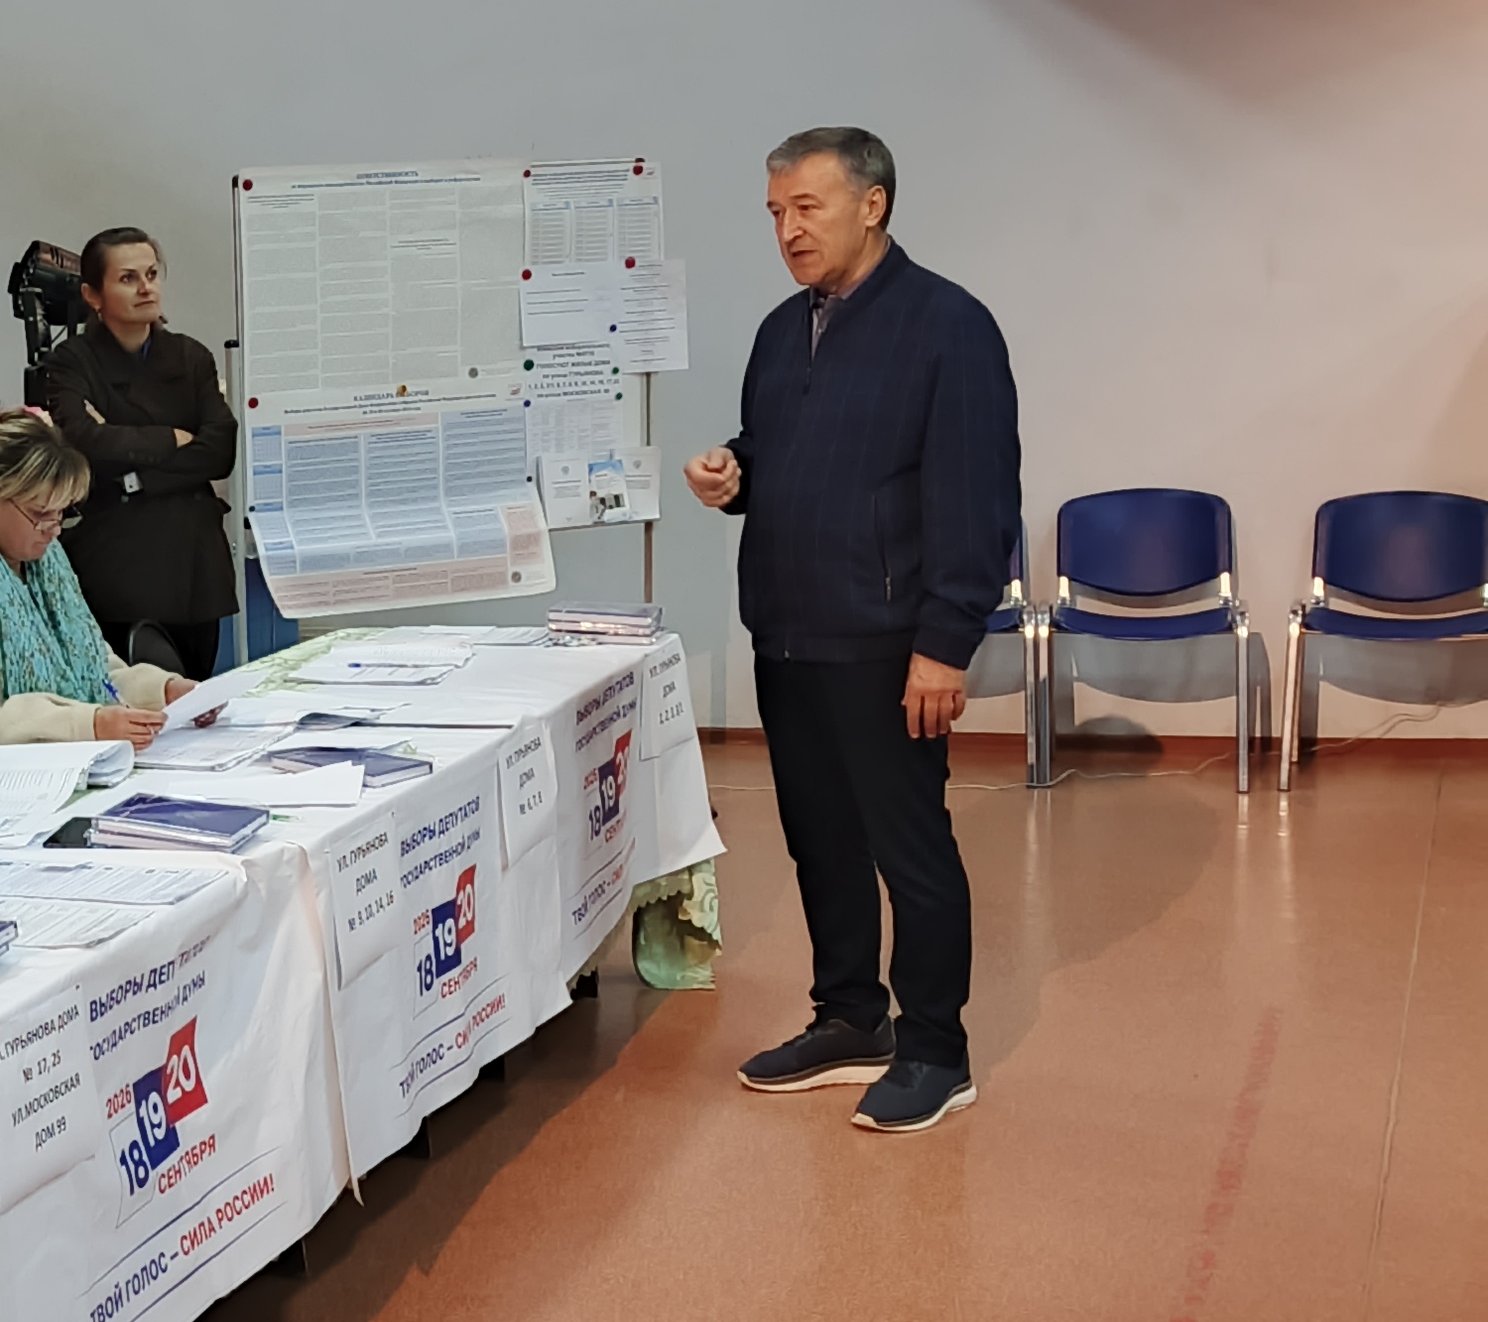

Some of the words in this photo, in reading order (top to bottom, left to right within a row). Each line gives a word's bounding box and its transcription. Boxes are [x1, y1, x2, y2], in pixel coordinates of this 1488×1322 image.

[602, 776, 616, 811] 19
[400, 821, 436, 857] ВЫБОРЫ
[438, 795, 480, 837] ДЕПУТАТОВ
[589, 805, 601, 840] 18
[356, 868, 378, 896] ДОМА
[458, 883, 473, 929] 20
[435, 918, 457, 961] 19
[89, 973, 144, 1022] ВЫБОРЫ
[417, 953, 434, 996] 18
[5, 1019, 56, 1057] ГУРЬЯНОВА
[57, 1004, 80, 1034] ДОМА
[90, 986, 180, 1060] ОСУДАРСТВЕННОЙ
[181, 970, 206, 1006] ДУМЫ
[166, 1044, 197, 1104] 20
[106, 1084, 132, 1119] 2026
[139, 1091, 167, 1148] 19
[35, 1125, 56, 1152] ДОМ
[57, 1115, 67, 1135] 99
[119, 1140, 150, 1196] 18
[158, 1134, 216, 1194] СЕНТЯБРЯ
[125, 1251, 169, 1302] ГОЛОС
[180, 1216, 217, 1256] СИЛА
[216, 1173, 275, 1229] РОССИИ!
